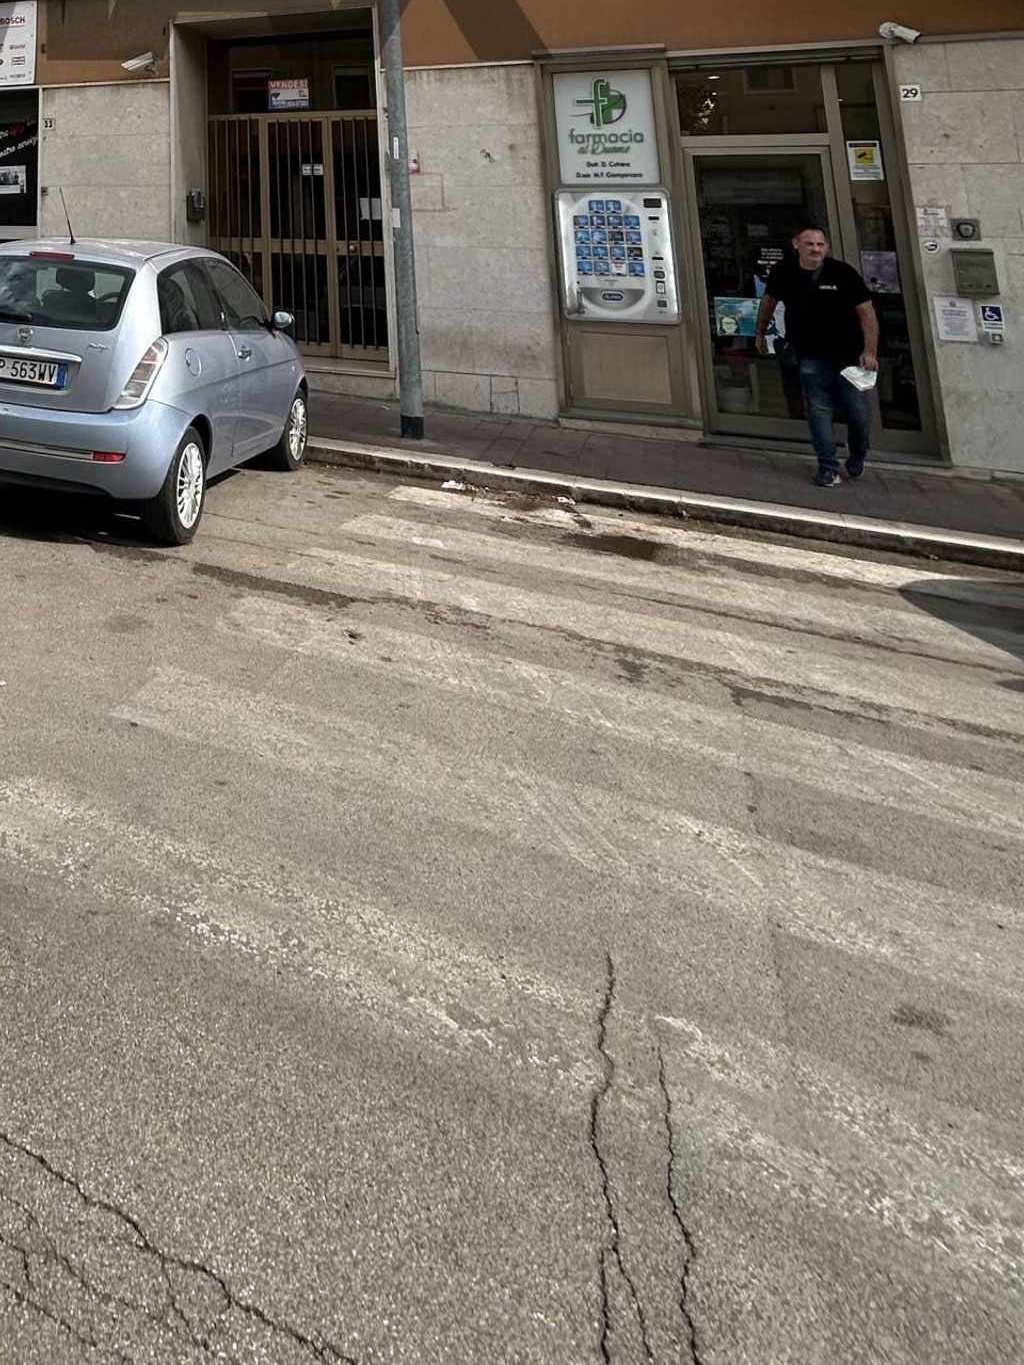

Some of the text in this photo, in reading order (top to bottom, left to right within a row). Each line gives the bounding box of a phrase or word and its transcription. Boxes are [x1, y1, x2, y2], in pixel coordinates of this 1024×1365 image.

[0, 16, 26, 25] BOSCH
[901, 88, 918, 98] 29
[568, 128, 644, 144] farmacia
[10, 360, 57, 383] 563WV
